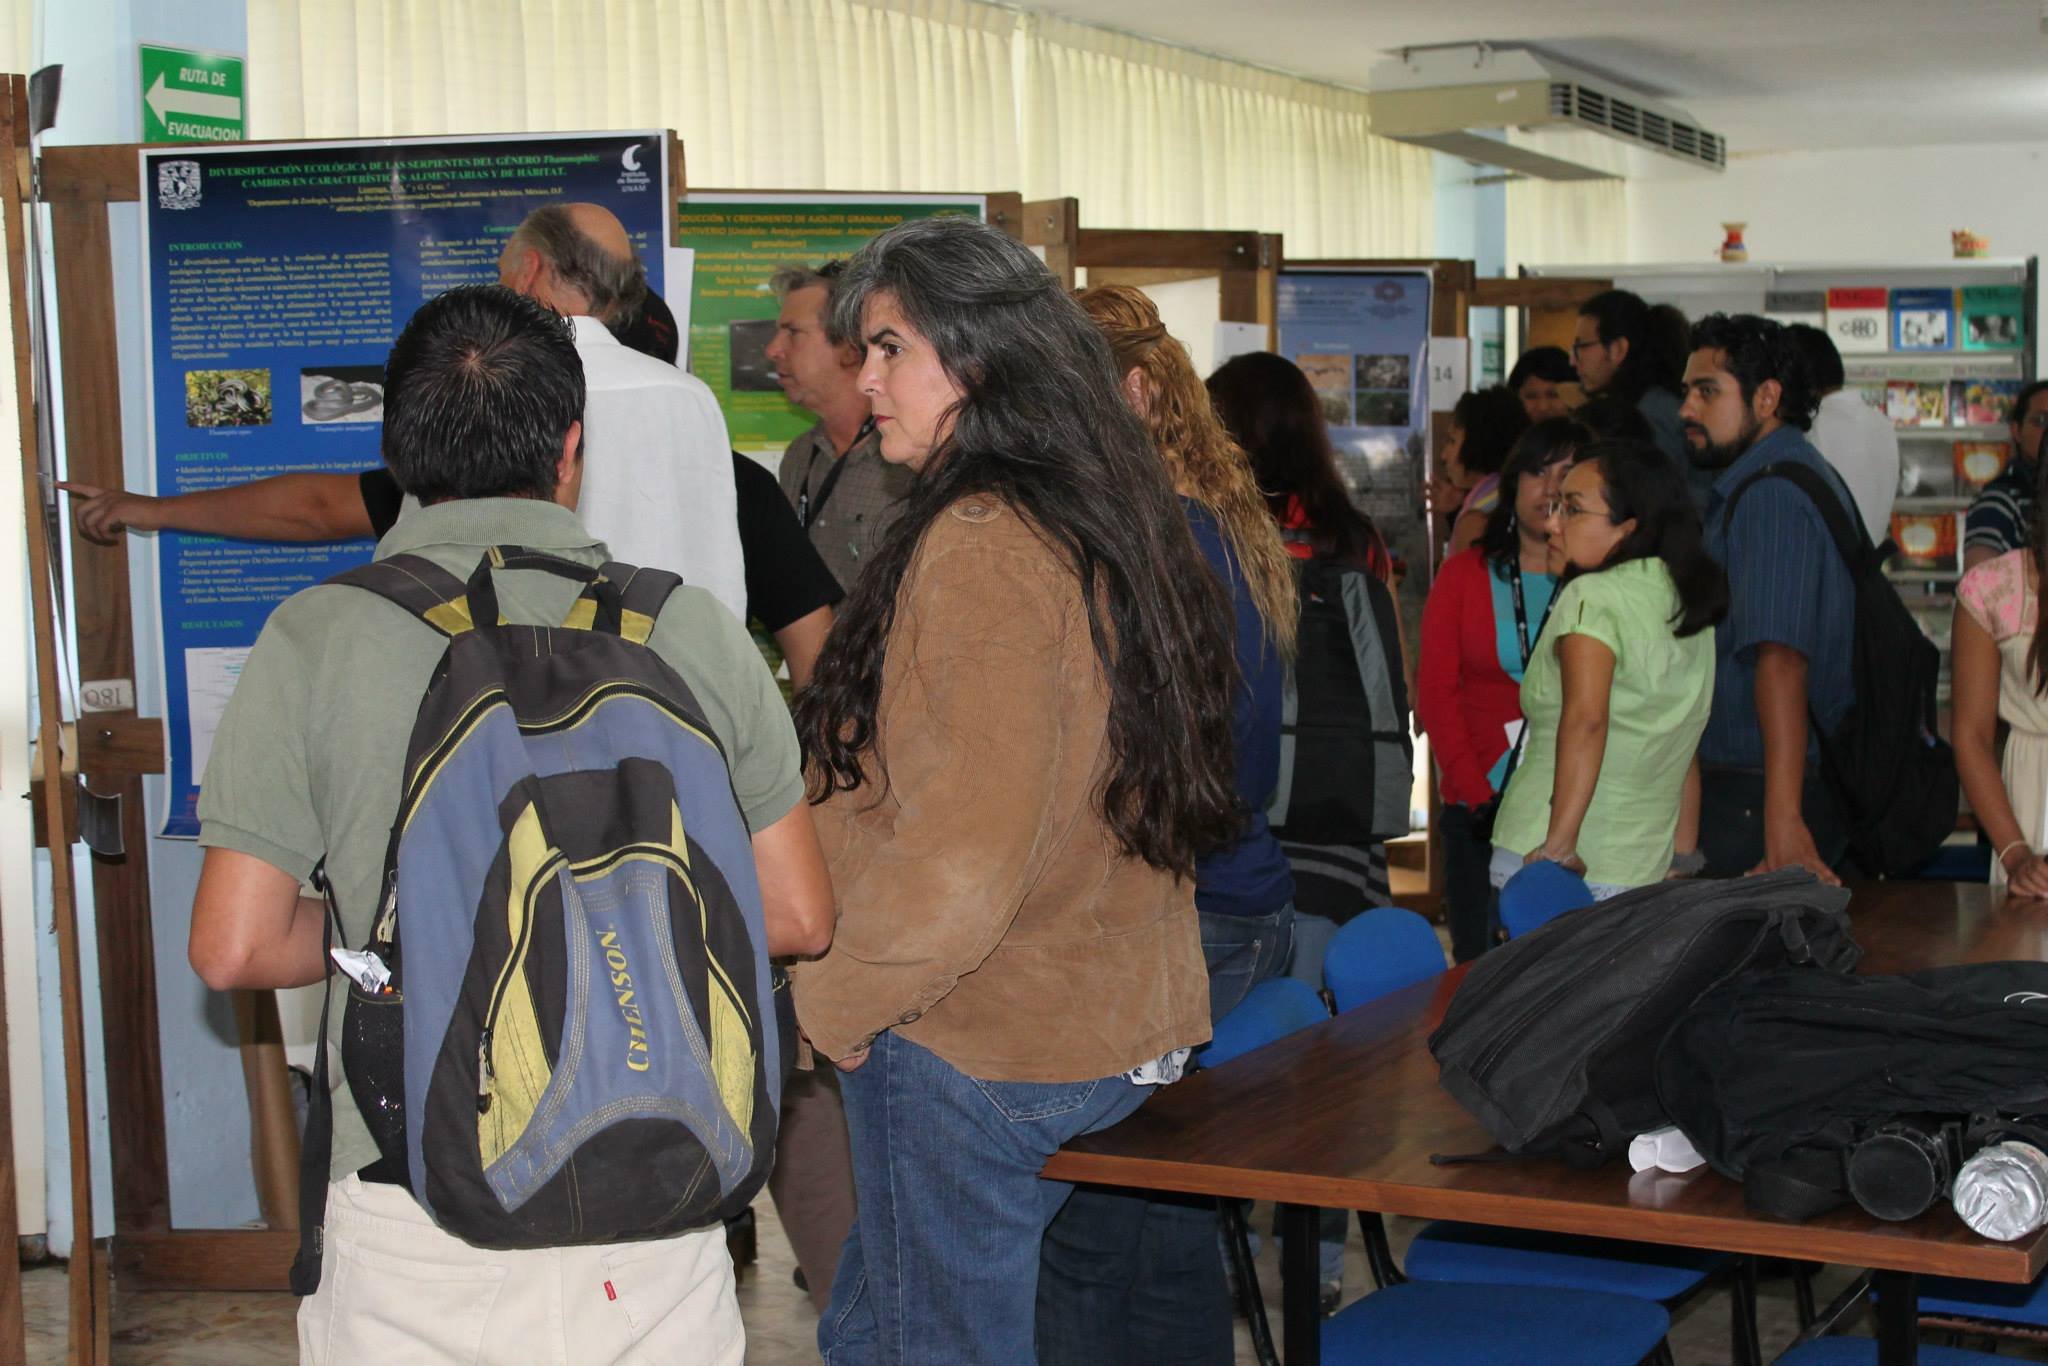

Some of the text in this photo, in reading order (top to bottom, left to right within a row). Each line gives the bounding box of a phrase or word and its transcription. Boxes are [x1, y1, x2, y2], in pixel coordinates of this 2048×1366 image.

[179, 67, 227, 86] RUTA DE
[209, 164, 302, 177] DIVERSIFICACIÓN
[304, 161, 367, 174] ECOLÓGICA
[369, 162, 384, 171] DE
[407, 157, 472, 170] SERPIENTES
[473, 157, 494, 166] DEL
[496, 154, 542, 165] GÉNERO
[169, 241, 243, 252] INTRODUCCIÓN
[1435, 366, 1453, 381] 14
[595, 929, 650, 1072] CHENSON
